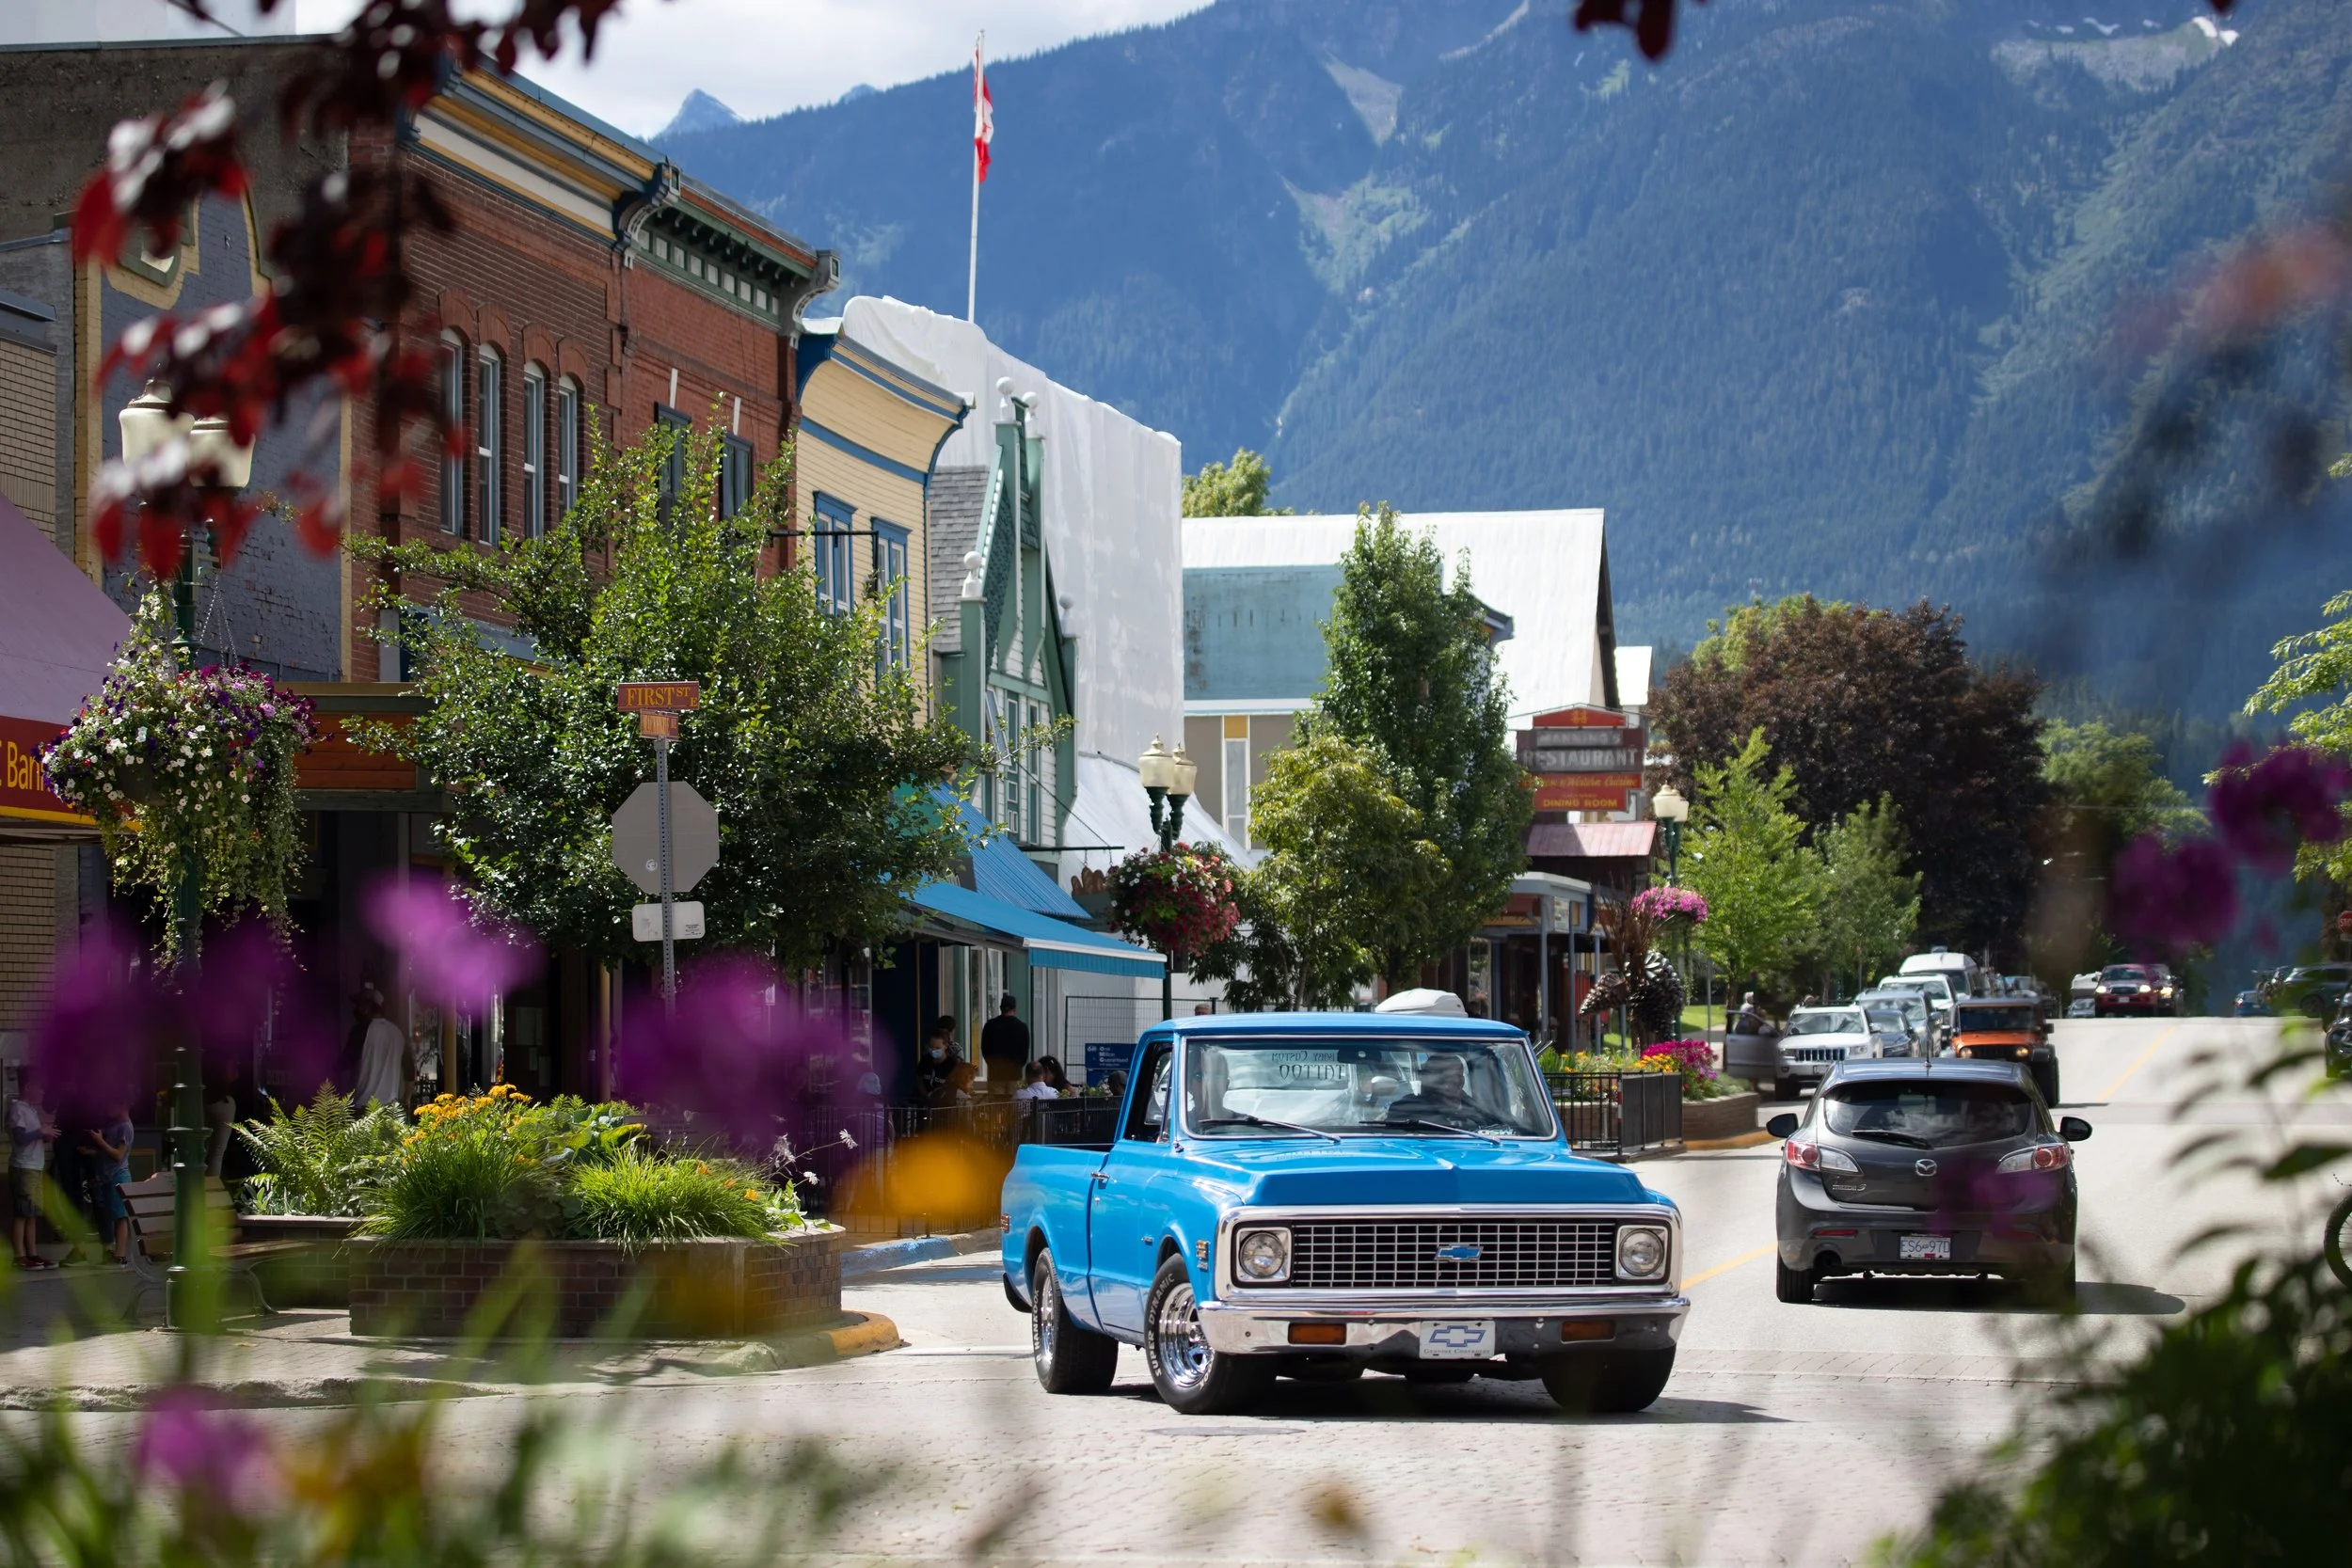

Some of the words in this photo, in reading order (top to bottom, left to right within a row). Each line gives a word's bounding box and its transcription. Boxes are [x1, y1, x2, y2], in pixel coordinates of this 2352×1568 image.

[626, 688, 675, 707] FIRST
[676, 688, 691, 697] ST
[690, 697, 698, 706] E
[1523, 750, 1638, 767] RESTAURANT
[1543, 799, 1580, 808] DINING
[1584, 799, 1617, 808] ROOM
[2340, 918, 2352, 927] STO
[1900, 1240, 1922, 1253] ES6
[1148, 1273, 1176, 1325] DYNAMIC
[1148, 1330, 1162, 1377] SUPER
